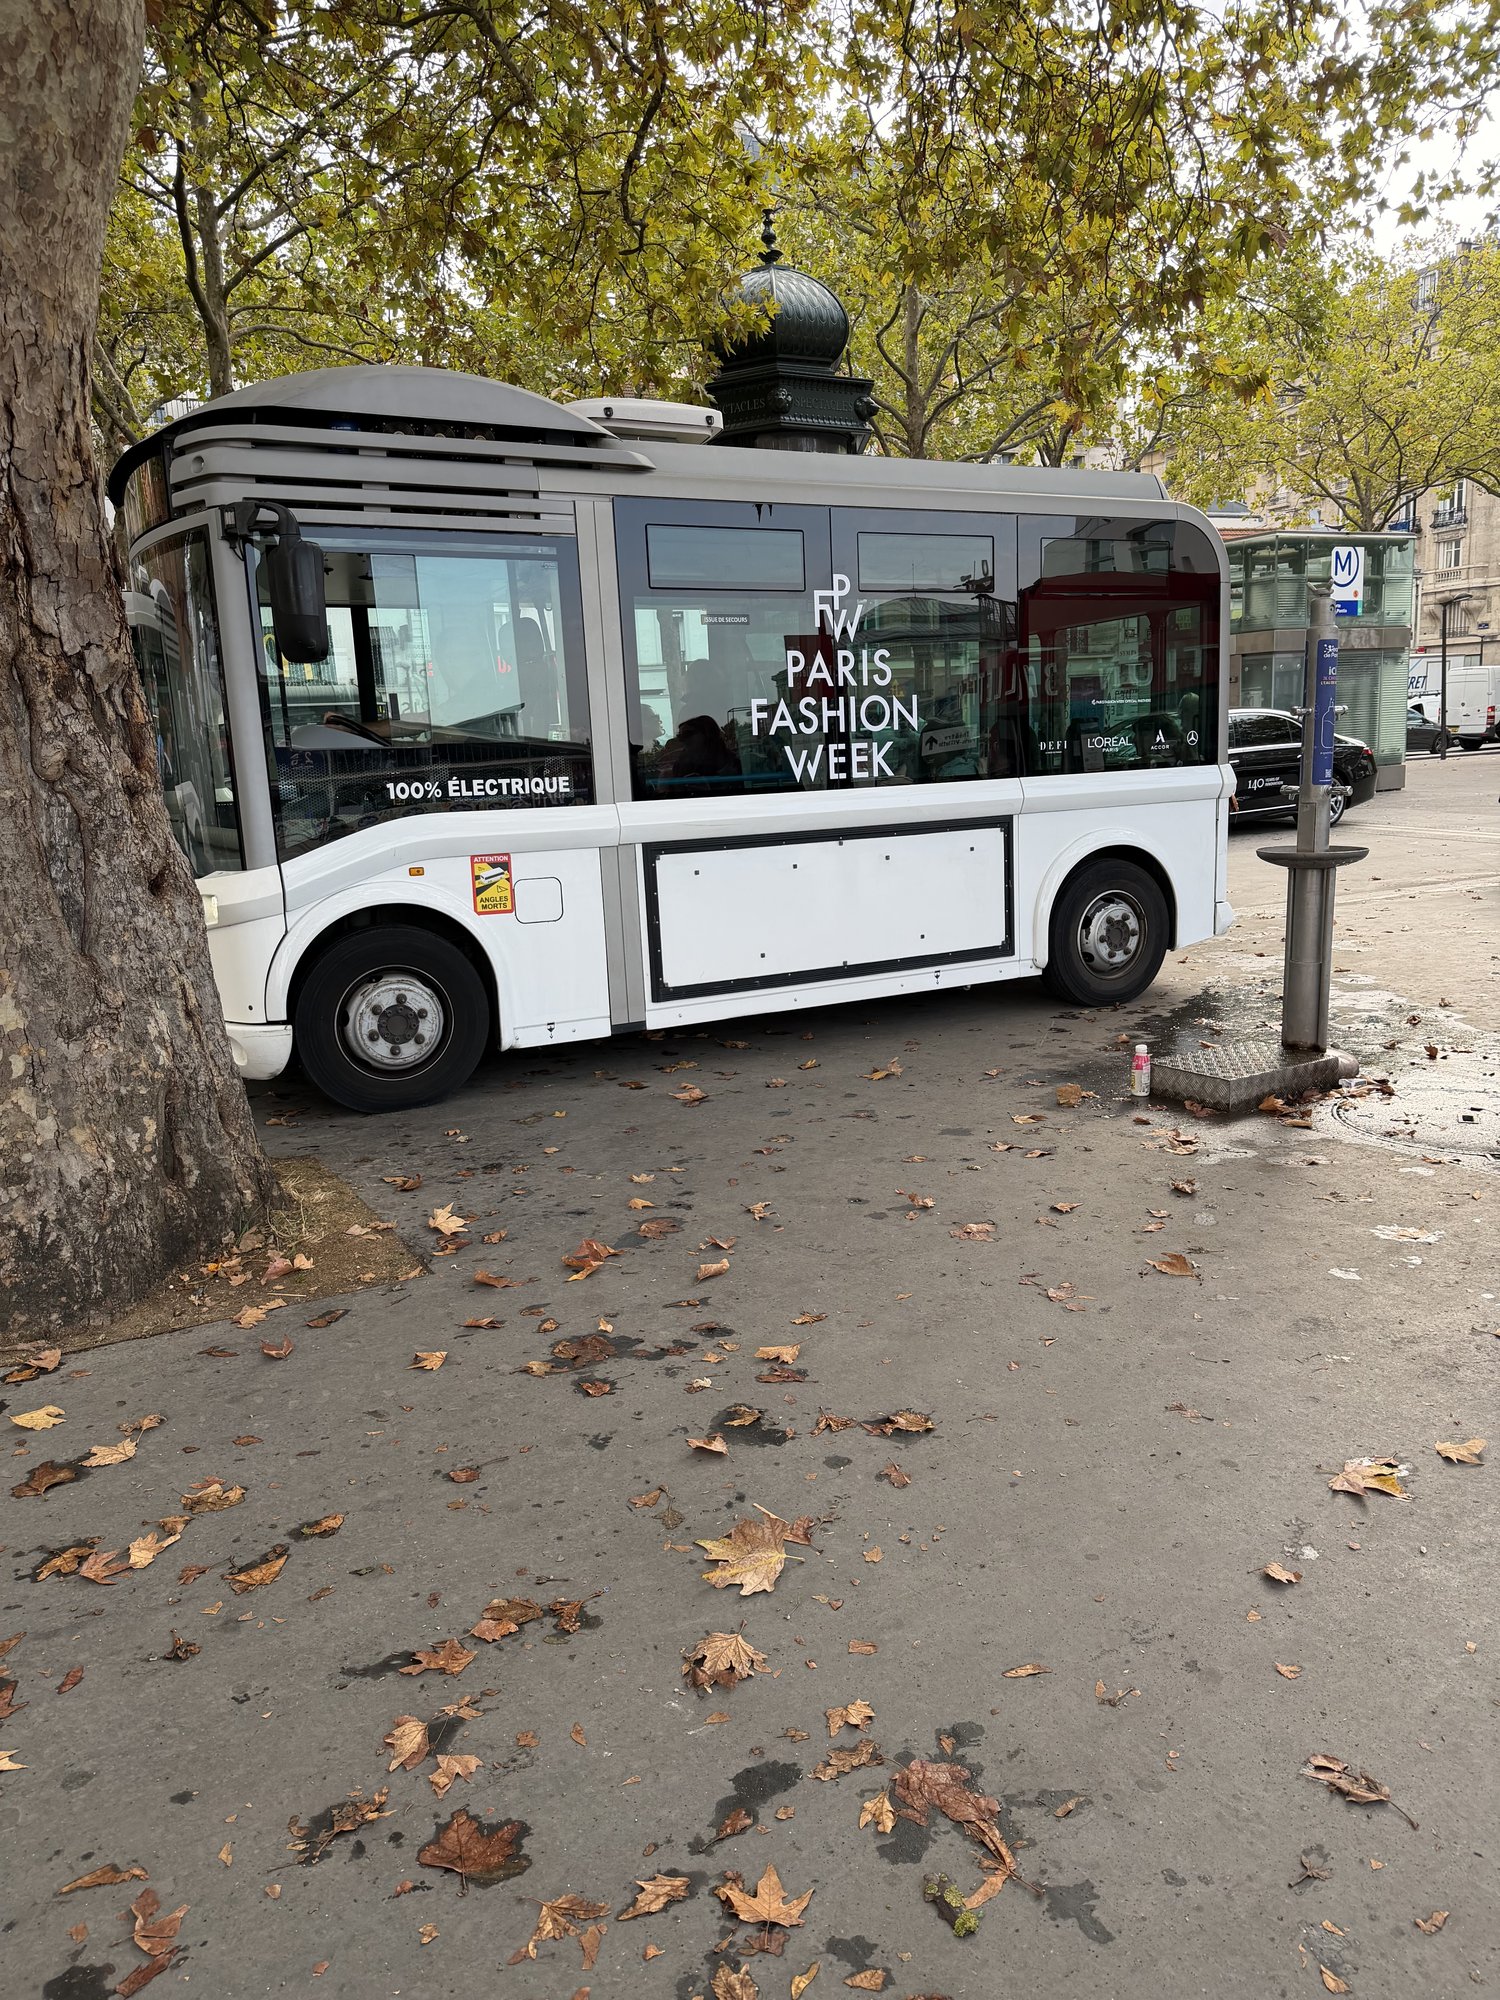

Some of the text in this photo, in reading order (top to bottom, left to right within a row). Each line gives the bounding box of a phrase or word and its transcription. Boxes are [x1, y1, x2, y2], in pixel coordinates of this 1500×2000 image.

[794, 396, 854, 412] SPECTACLES
[1334, 550, 1352, 576] M
[786, 649, 892, 688] PARIS
[1408, 676, 1428, 689] RET
[751, 694, 918, 736] FASHION
[1040, 740, 1067, 751] DEFI
[1087, 736, 1133, 748] L'ORÉAL
[783, 741, 894, 783] WEEK
[386, 776, 571, 800] 100% ÉLECTRIQUE
[1248, 778, 1265, 791] 140
[473, 855, 509, 863] ATTENTION
[479, 895, 509, 903] ANGLES
